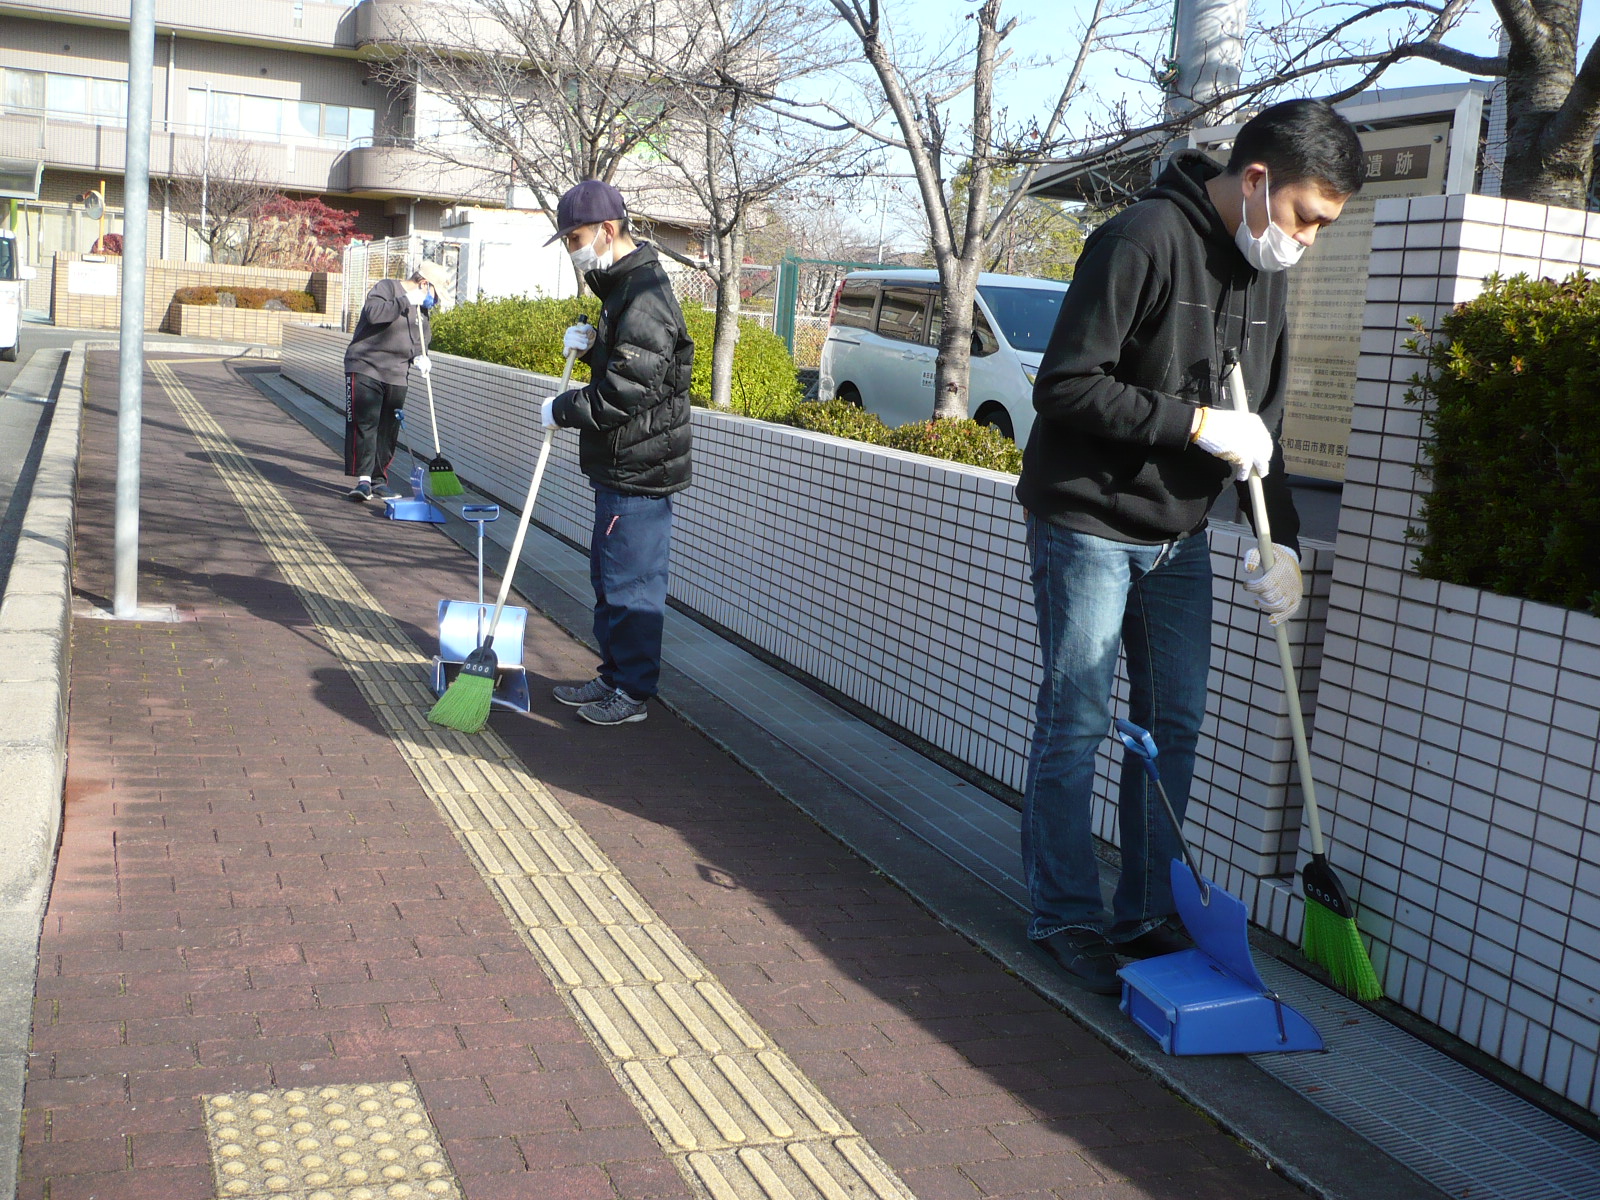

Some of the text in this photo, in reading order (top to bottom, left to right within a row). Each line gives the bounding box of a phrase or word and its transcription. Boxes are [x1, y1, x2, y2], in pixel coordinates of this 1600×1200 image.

[1365, 150, 1414, 178] 遺跡
[1280, 437, 1348, 457] 大和高田市教育委
